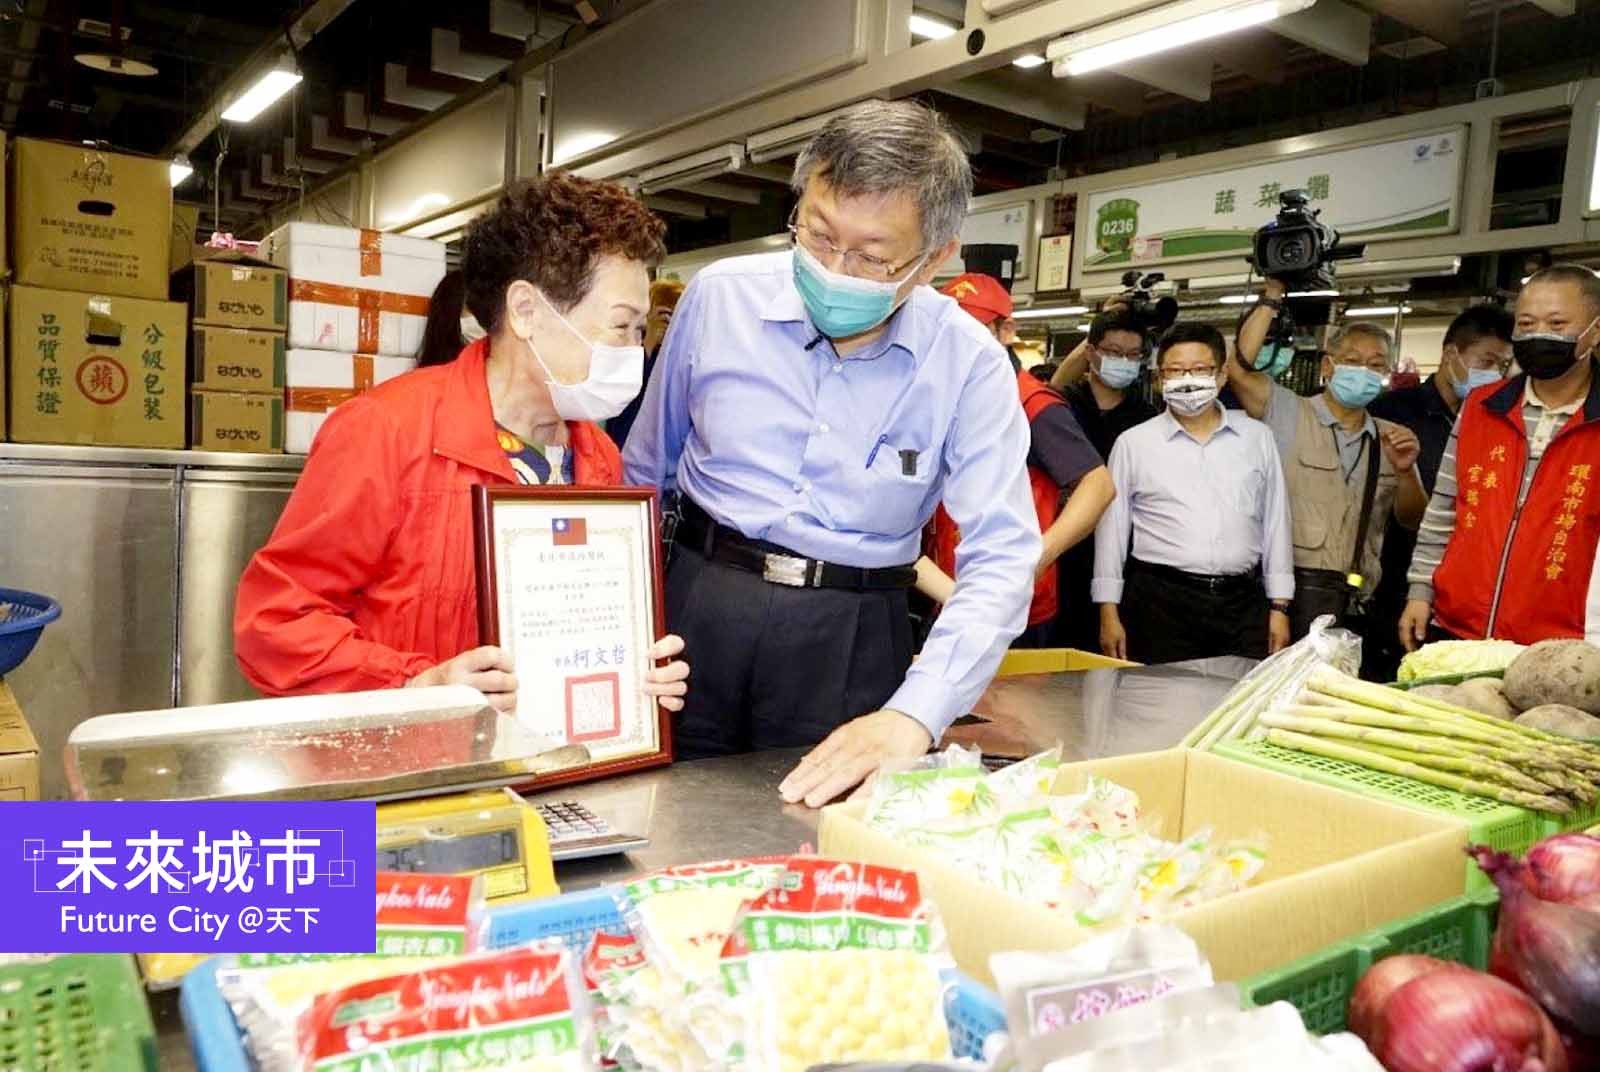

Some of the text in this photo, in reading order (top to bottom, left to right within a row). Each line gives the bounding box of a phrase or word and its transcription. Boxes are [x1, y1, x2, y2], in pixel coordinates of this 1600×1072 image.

[1102, 218, 1135, 236] 0236
[37, 312, 63, 416] 品質保證
[141, 322, 165, 422] 分級包裝
